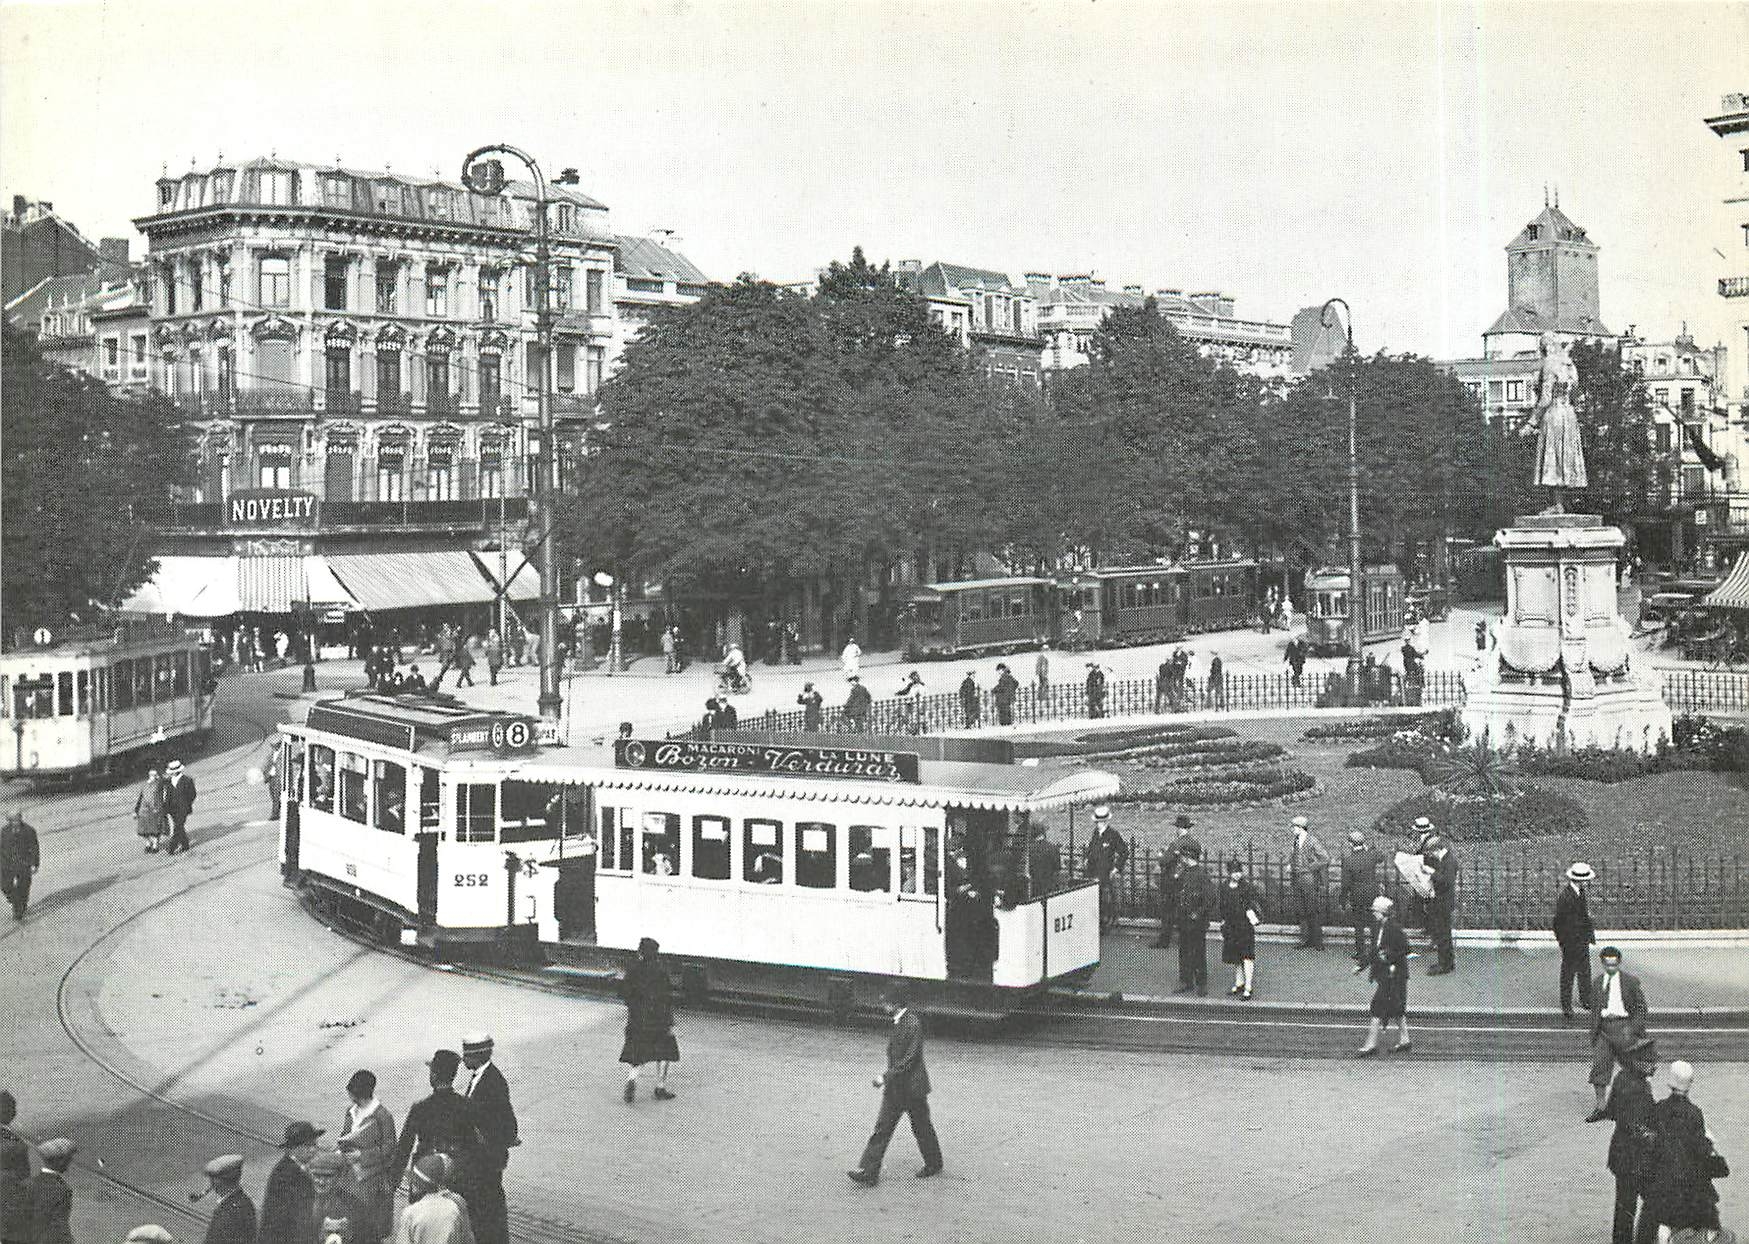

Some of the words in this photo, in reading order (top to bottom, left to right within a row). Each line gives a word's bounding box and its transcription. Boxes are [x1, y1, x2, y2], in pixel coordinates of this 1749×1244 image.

[232, 496, 314, 521] NOVELTY
[511, 724, 525, 745] 8
[655, 744, 738, 771] Bozon
[764, 749, 901, 781] Verduraz
[687, 743, 760, 755] MACARONI
[819, 750, 838, 760] LA
[845, 751, 896, 763] LUNE
[454, 874, 489, 887] 252
